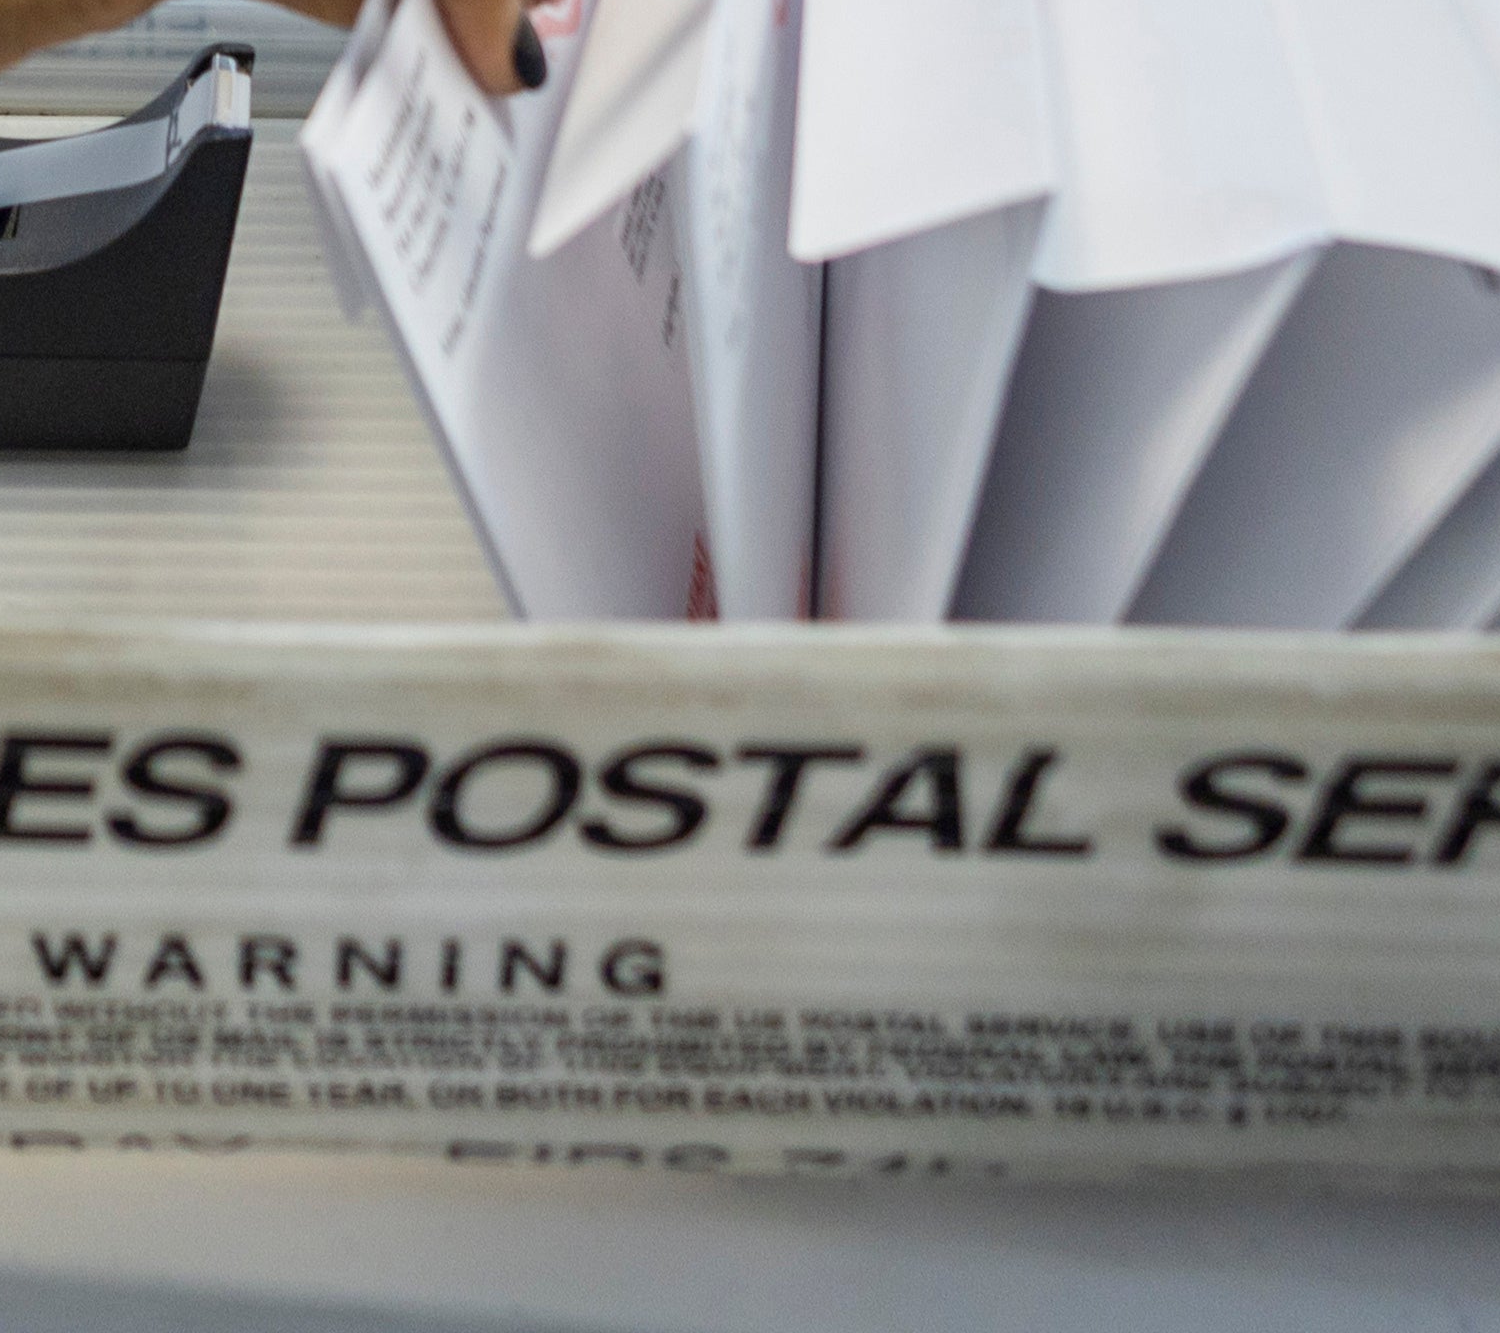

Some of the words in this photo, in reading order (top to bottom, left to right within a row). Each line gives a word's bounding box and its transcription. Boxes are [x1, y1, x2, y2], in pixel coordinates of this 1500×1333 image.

[287, 736, 1095, 856] POSTAL
[30, 930, 667, 997] WARNING
[495, 1084, 603, 1113] BOTH
[612, 1085, 693, 1114] FOR
[703, 1088, 811, 1116] EACH
